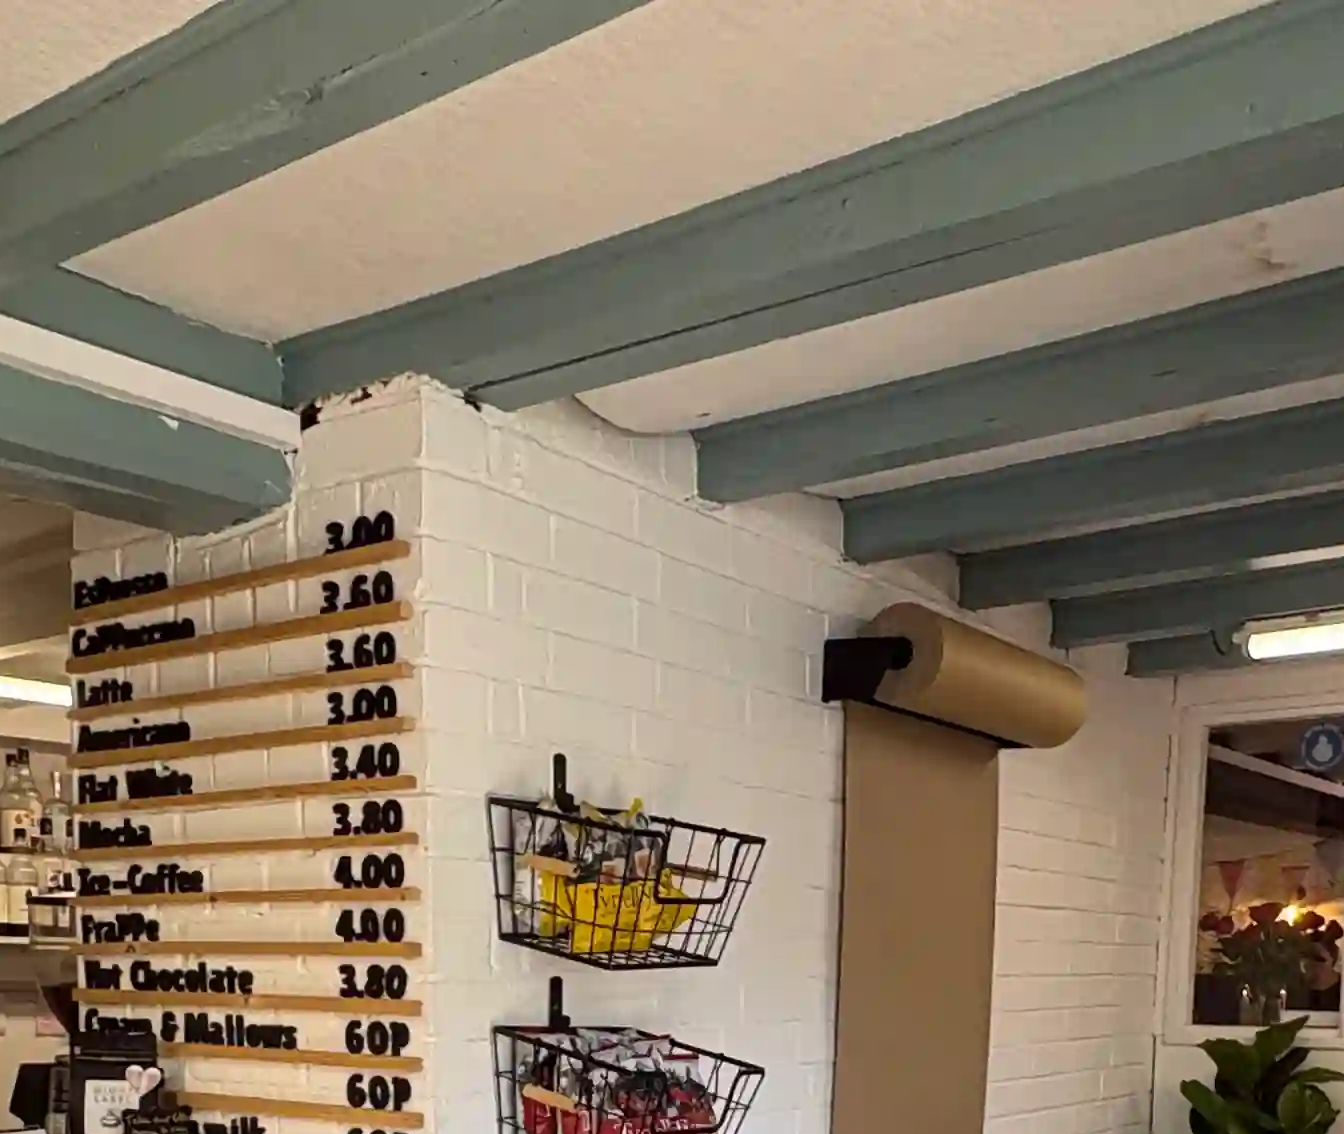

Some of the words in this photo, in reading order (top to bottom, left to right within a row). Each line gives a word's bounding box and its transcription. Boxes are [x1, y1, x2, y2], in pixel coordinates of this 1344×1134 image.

[324, 510, 395, 556] 3.00
[319, 571, 394, 614] 3.60
[326, 631, 397, 673] 3.60
[78, 678, 134, 707] Latte
[327, 685, 398, 726] 3.00
[331, 742, 401, 780] 3.40
[78, 818, 153, 848] Mocha
[332, 799, 403, 836] 3.80
[334, 853, 405, 889] 4.00
[335, 908, 406, 942] 4.00
[84, 960, 124, 990] Hot
[130, 960, 254, 994] Chocolate
[338, 964, 409, 1000] 3.80
[183, 1011, 298, 1049] Mallows
